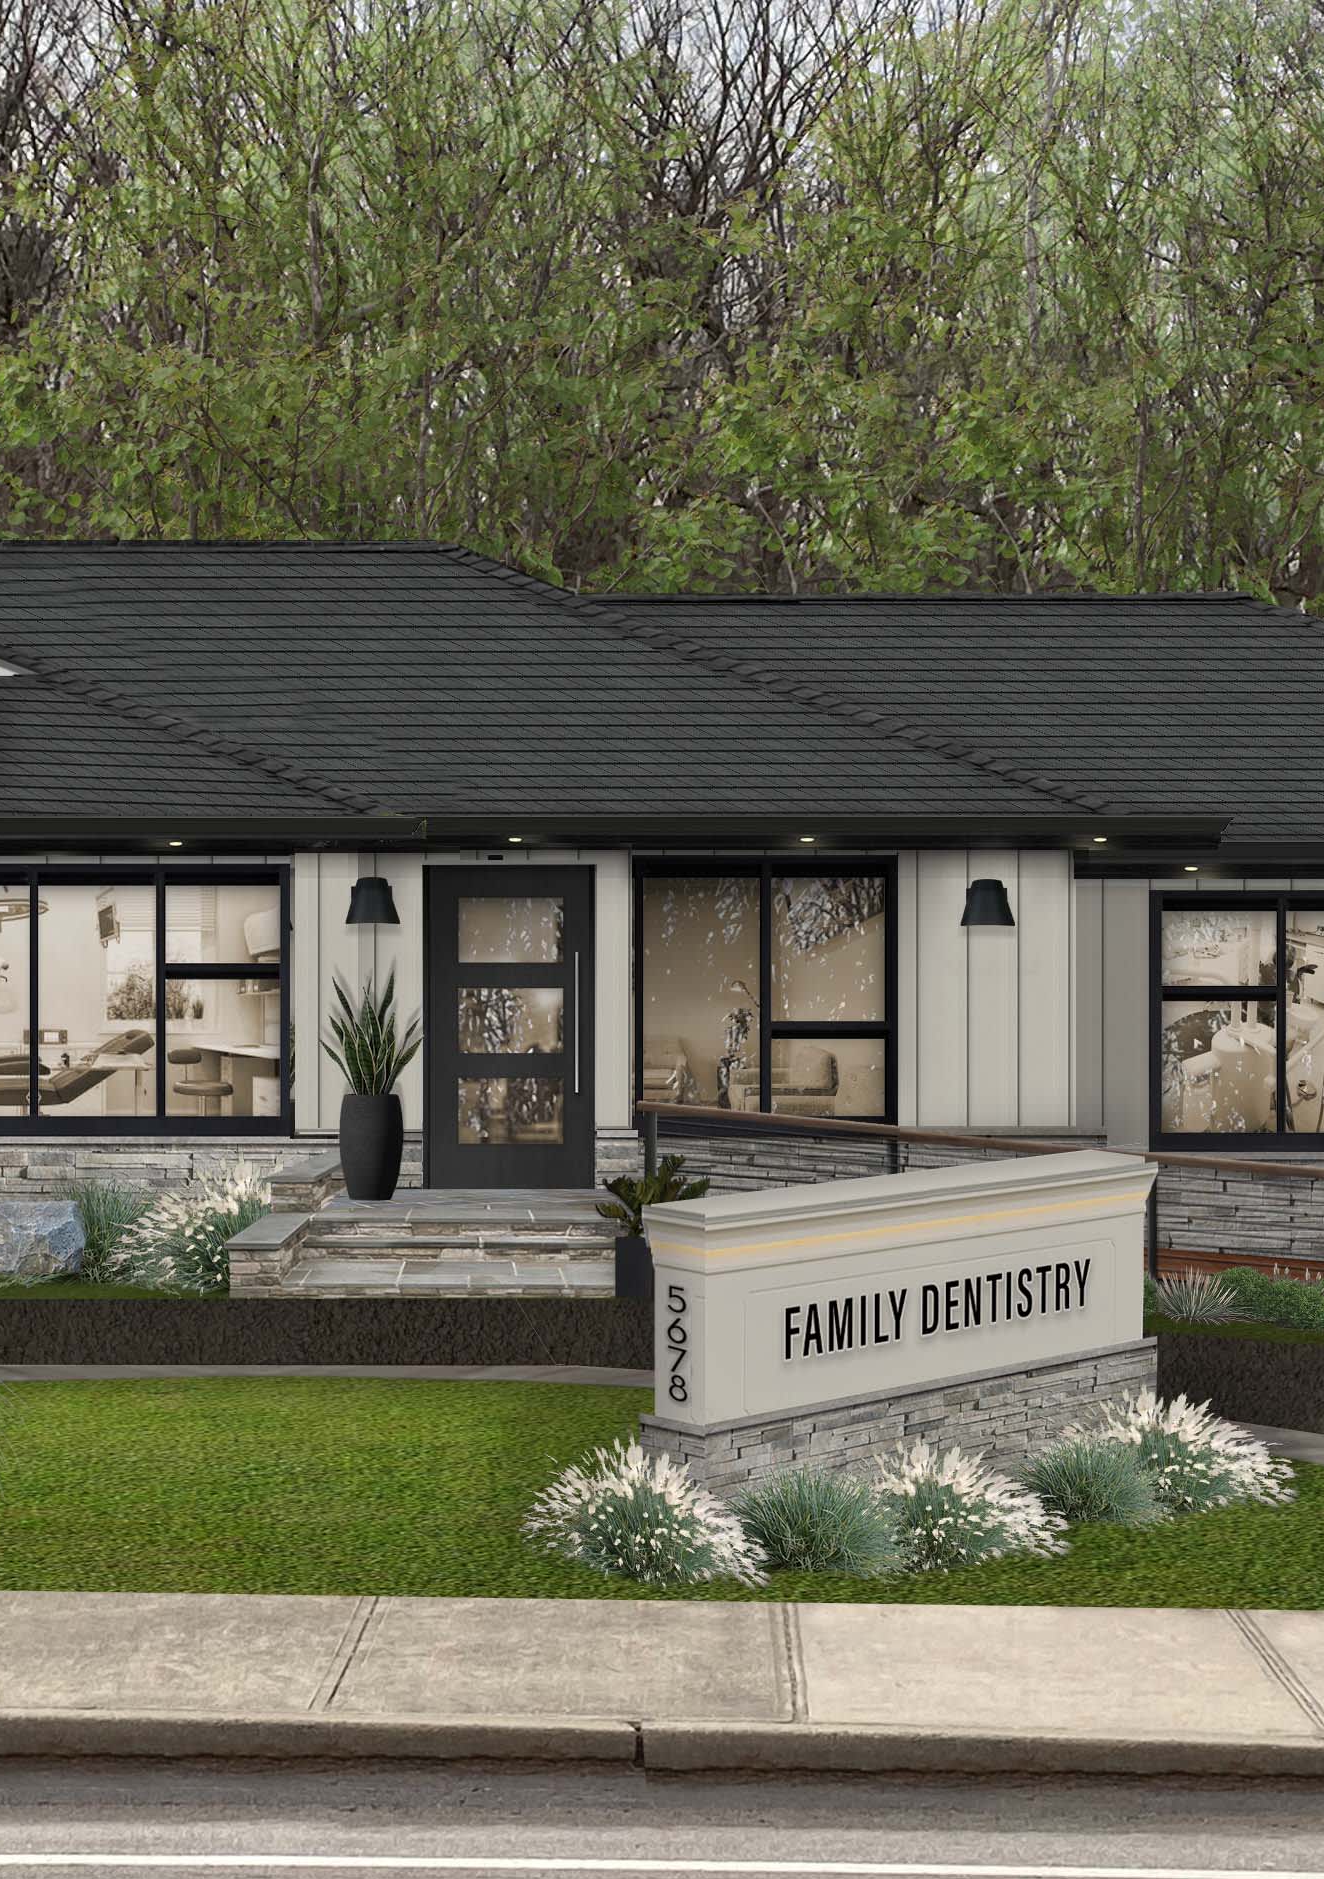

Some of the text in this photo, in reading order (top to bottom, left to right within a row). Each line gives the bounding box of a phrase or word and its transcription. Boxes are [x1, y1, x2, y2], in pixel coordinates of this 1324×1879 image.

[666, 1284, 689, 1403] 5678
[784, 1257, 1092, 1361] FAMILY DENTISTRY
